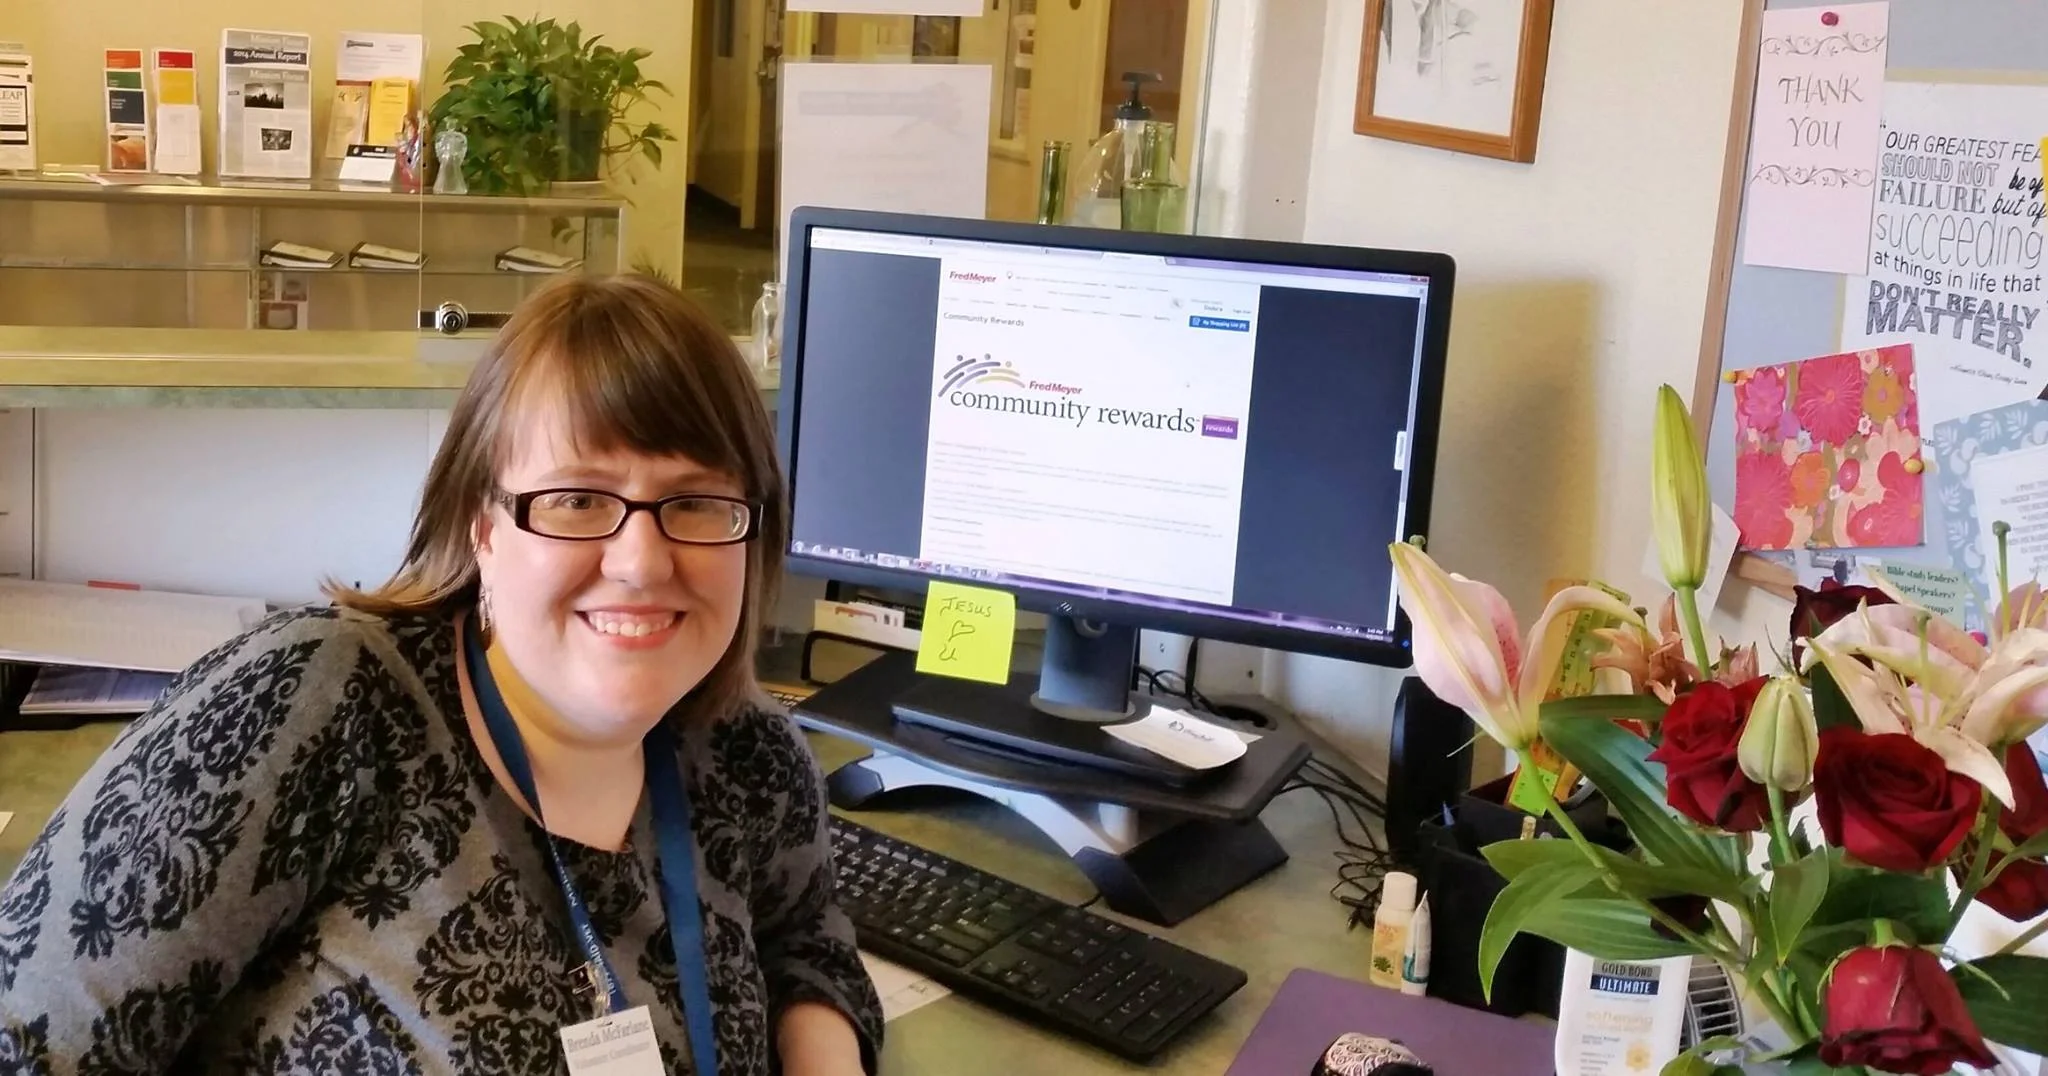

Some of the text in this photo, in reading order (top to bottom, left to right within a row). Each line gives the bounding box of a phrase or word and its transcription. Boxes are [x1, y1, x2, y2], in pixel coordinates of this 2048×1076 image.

[250, 50, 276, 60] Annual
[278, 52, 301, 62] Report
[0, 91, 23, 101] EAP
[1777, 74, 1864, 105] THANK
[1788, 116, 1842, 150] YOU
[1923, 135, 2009, 160] GREATEST
[2011, 143, 2043, 163] FEA
[1881, 152, 2045, 199] SHOULD NOT be of
[1879, 178, 2048, 228] FAILURE but of
[1875, 212, 2044, 269] succeeding
[1873, 250, 2041, 293] at things in life that
[943, 311, 1025, 328] Community Rewards
[1868, 279, 2041, 330] DON'T REALLY
[1865, 300, 2033, 369] MATTER.
[950, 386, 1091, 428] community
[1097, 404, 1196, 434] rewards
[1894, 582, 1916, 594] hapel
[940, 596, 992, 618] JESUS
[1600, 977, 1651, 994] ULTIMATE
[1602, 962, 1653, 979] GOLD BOND
